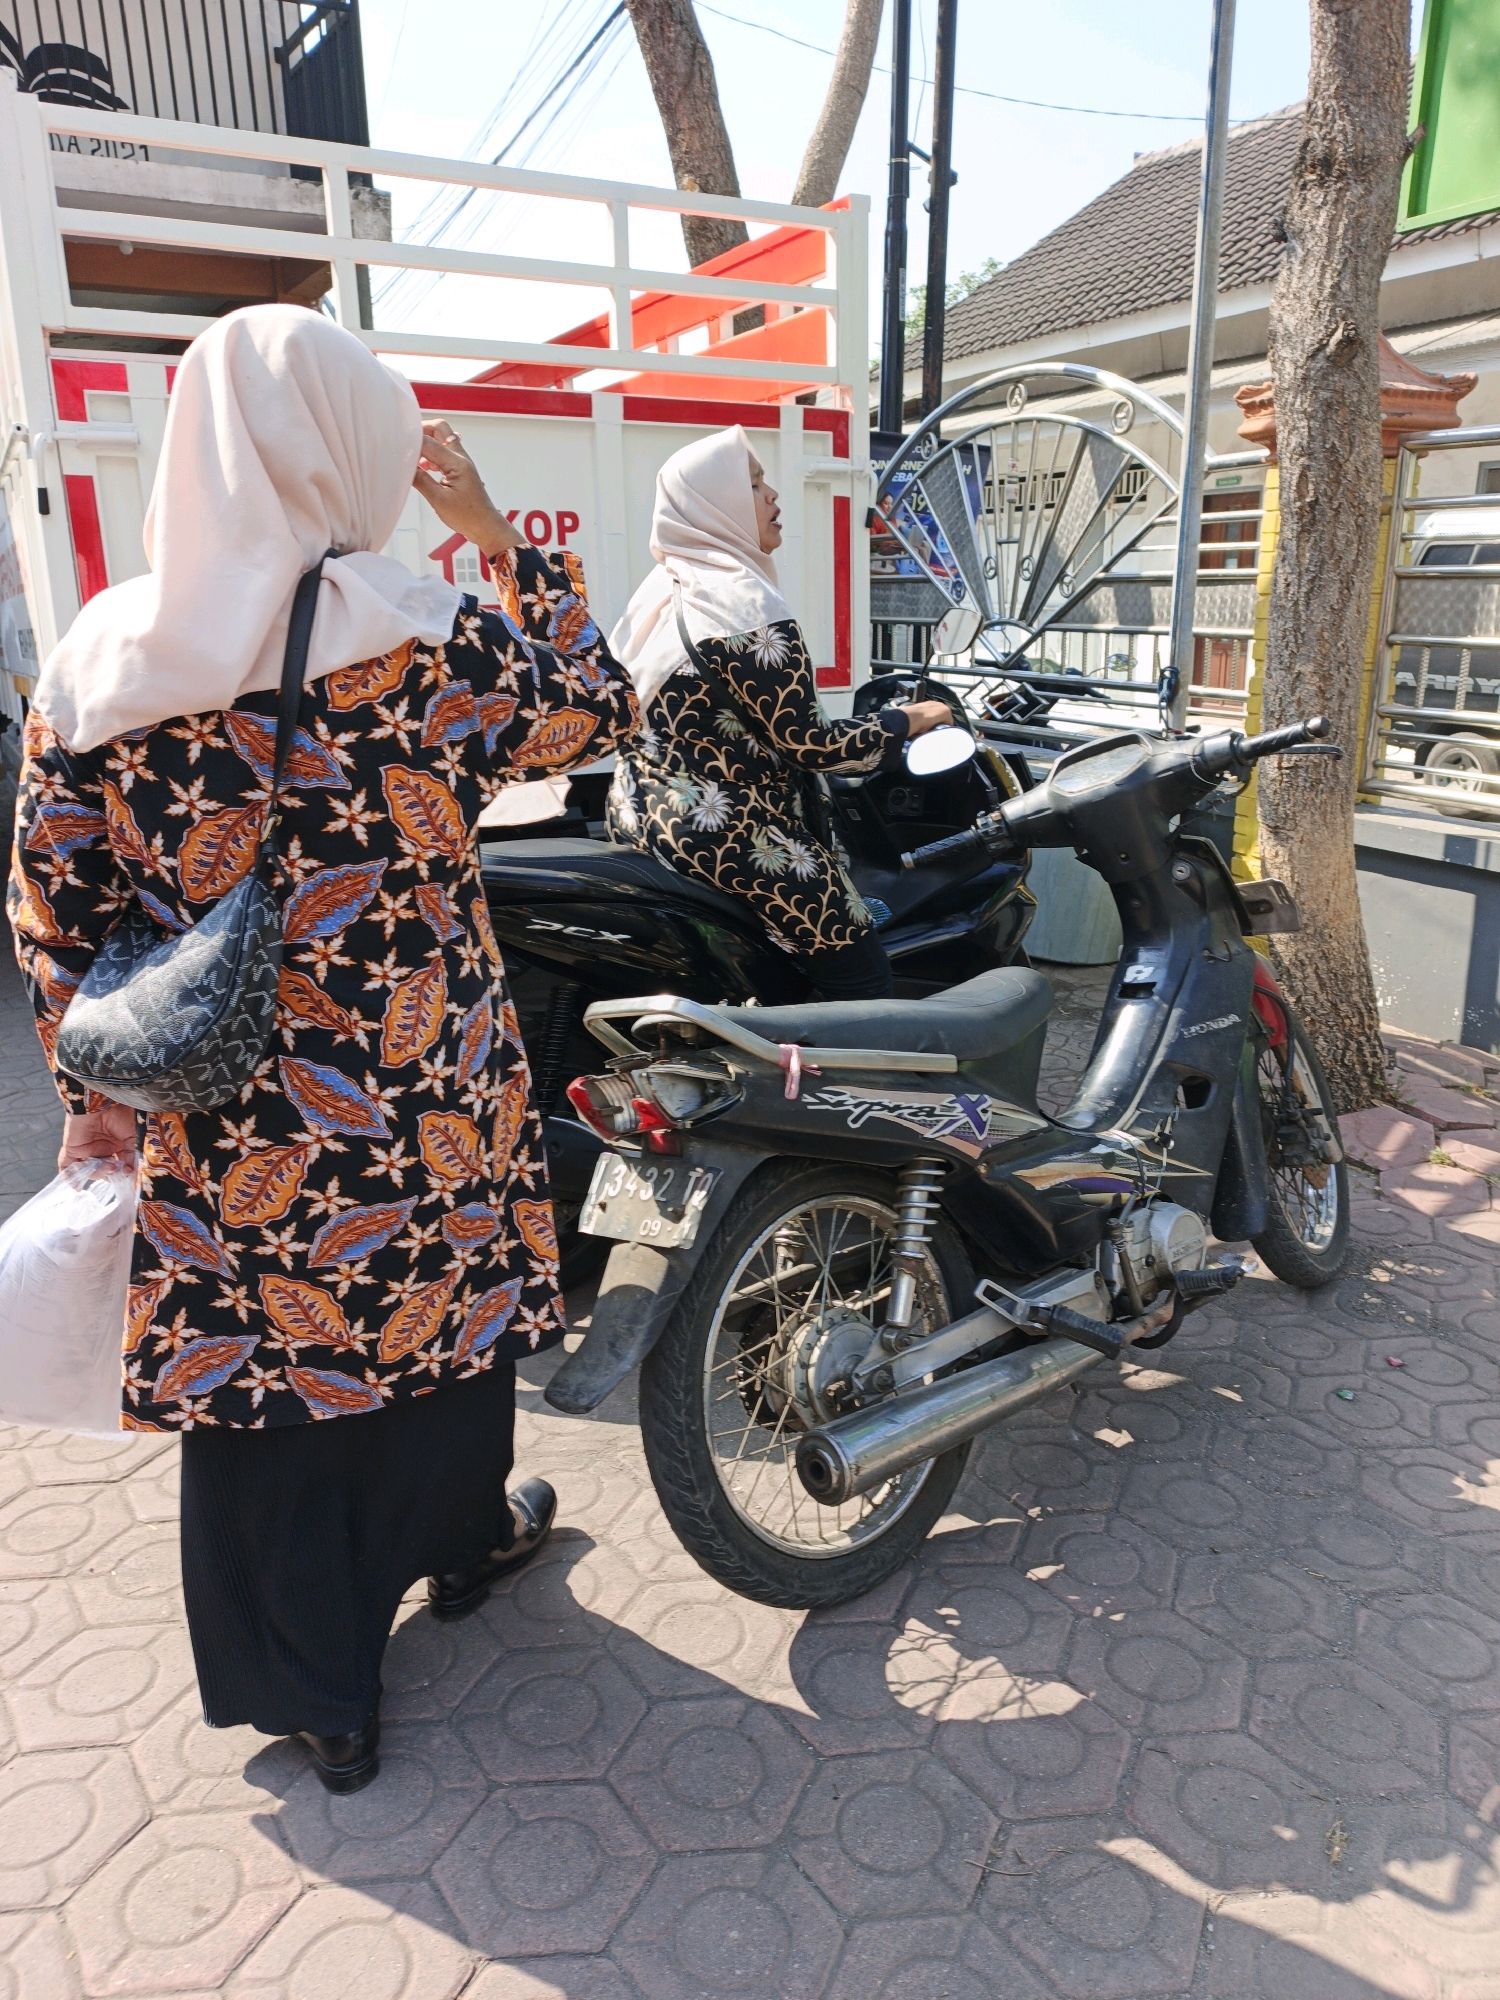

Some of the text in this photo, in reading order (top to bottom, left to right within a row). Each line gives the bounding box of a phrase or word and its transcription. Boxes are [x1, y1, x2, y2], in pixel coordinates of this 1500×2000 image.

[525, 918, 632, 945] PCX
[801, 1086, 993, 1141] Supra X
[607, 1163, 675, 1202] 3432
[639, 1219, 662, 1237] 09
